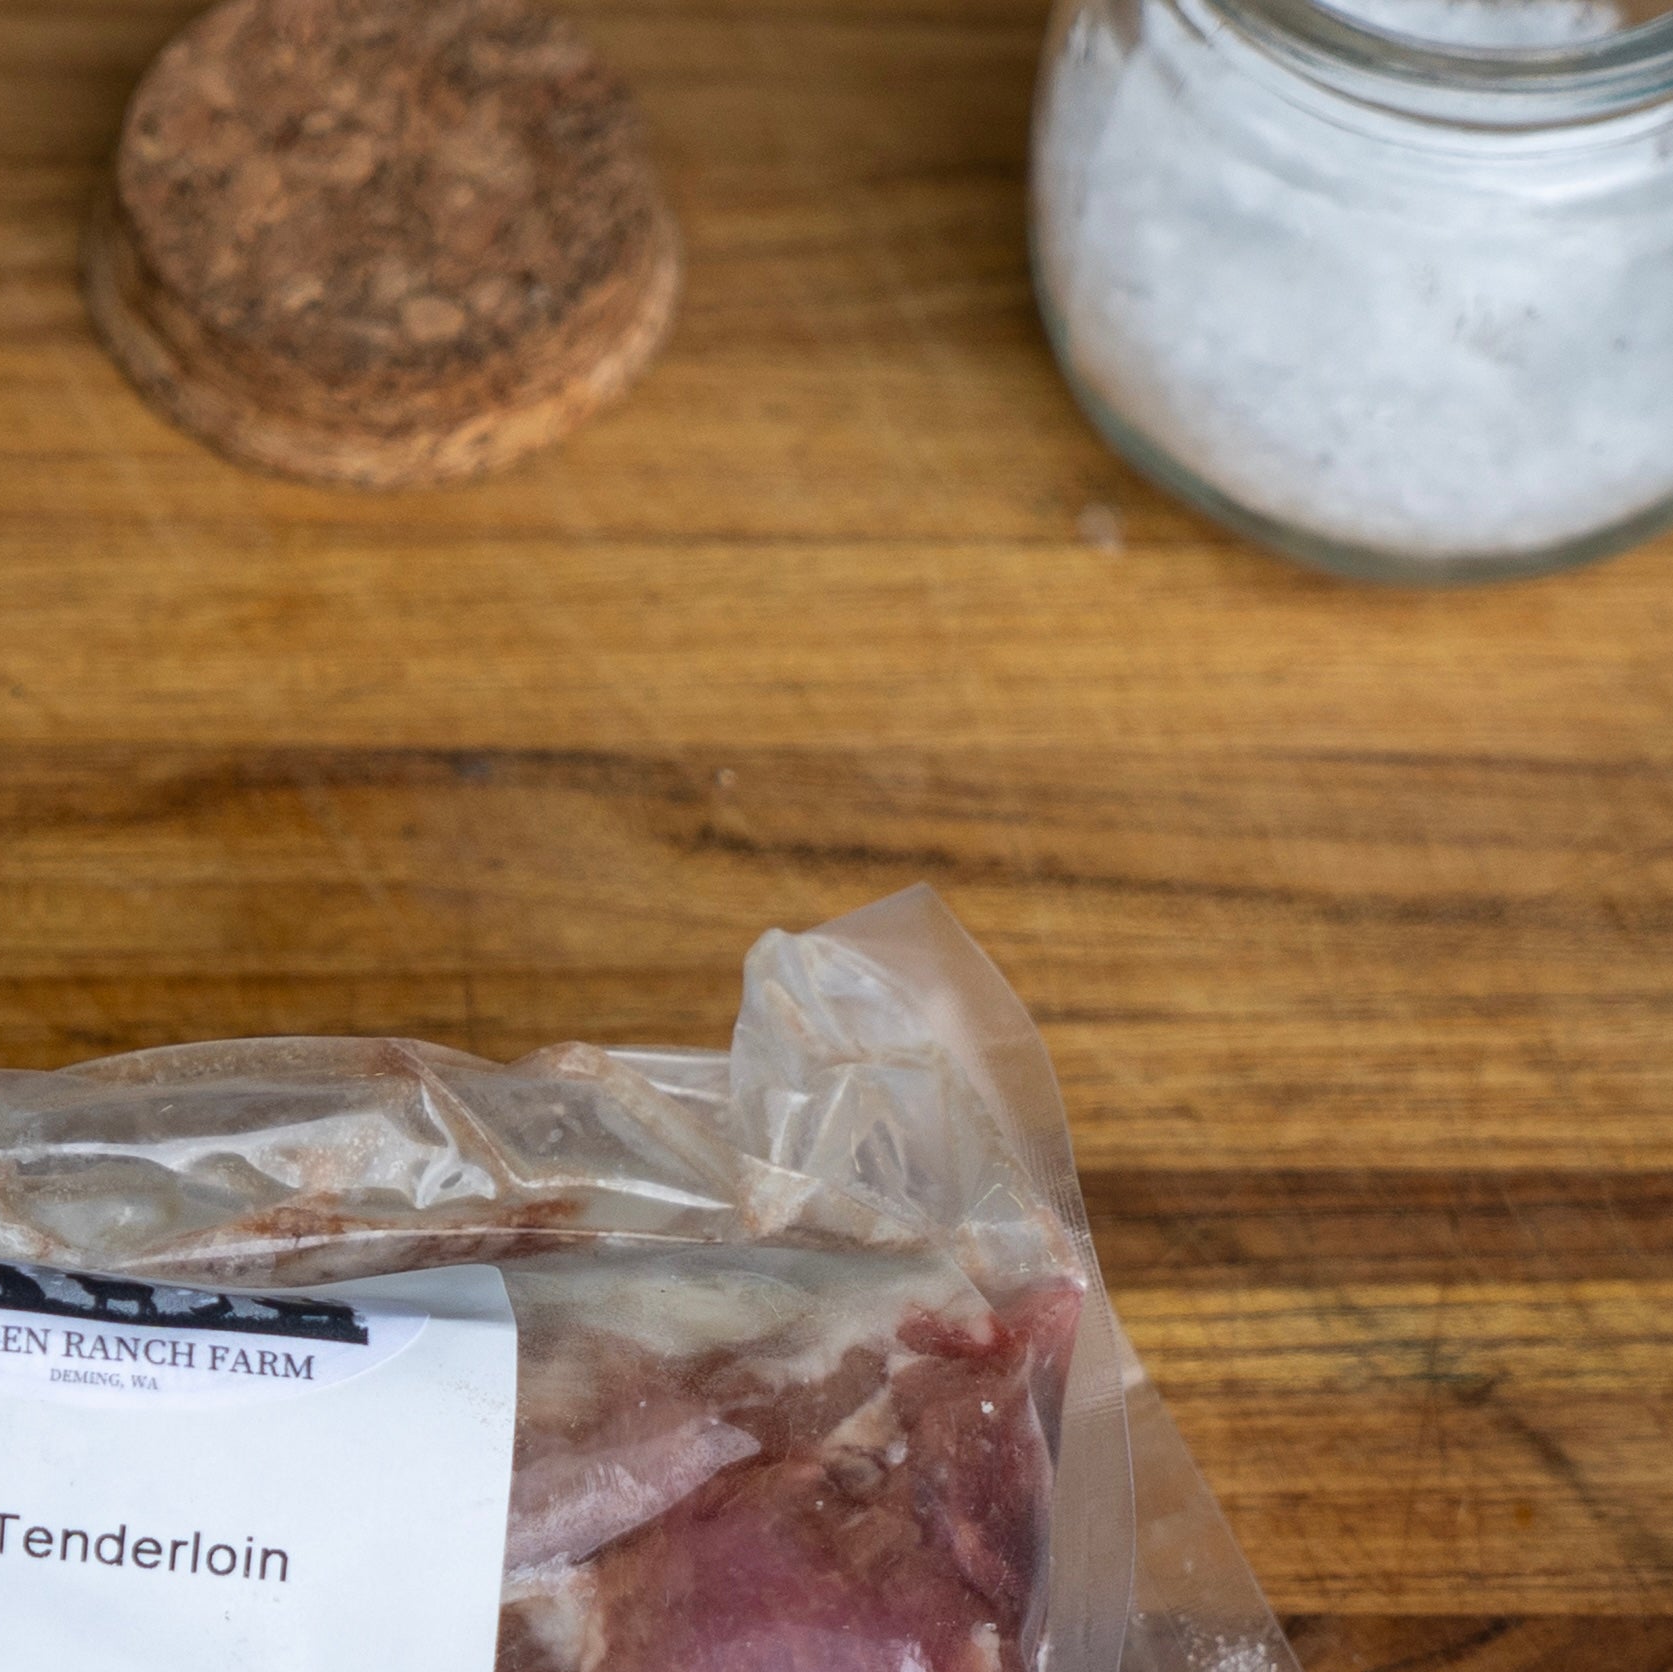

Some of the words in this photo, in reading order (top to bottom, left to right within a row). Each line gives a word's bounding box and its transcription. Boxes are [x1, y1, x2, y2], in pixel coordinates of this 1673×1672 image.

[62, 1330, 196, 1369] RANCH
[207, 1345, 316, 1381] FARM
[49, 1367, 126, 1390] DEMING,
[130, 1375, 160, 1391] WA
